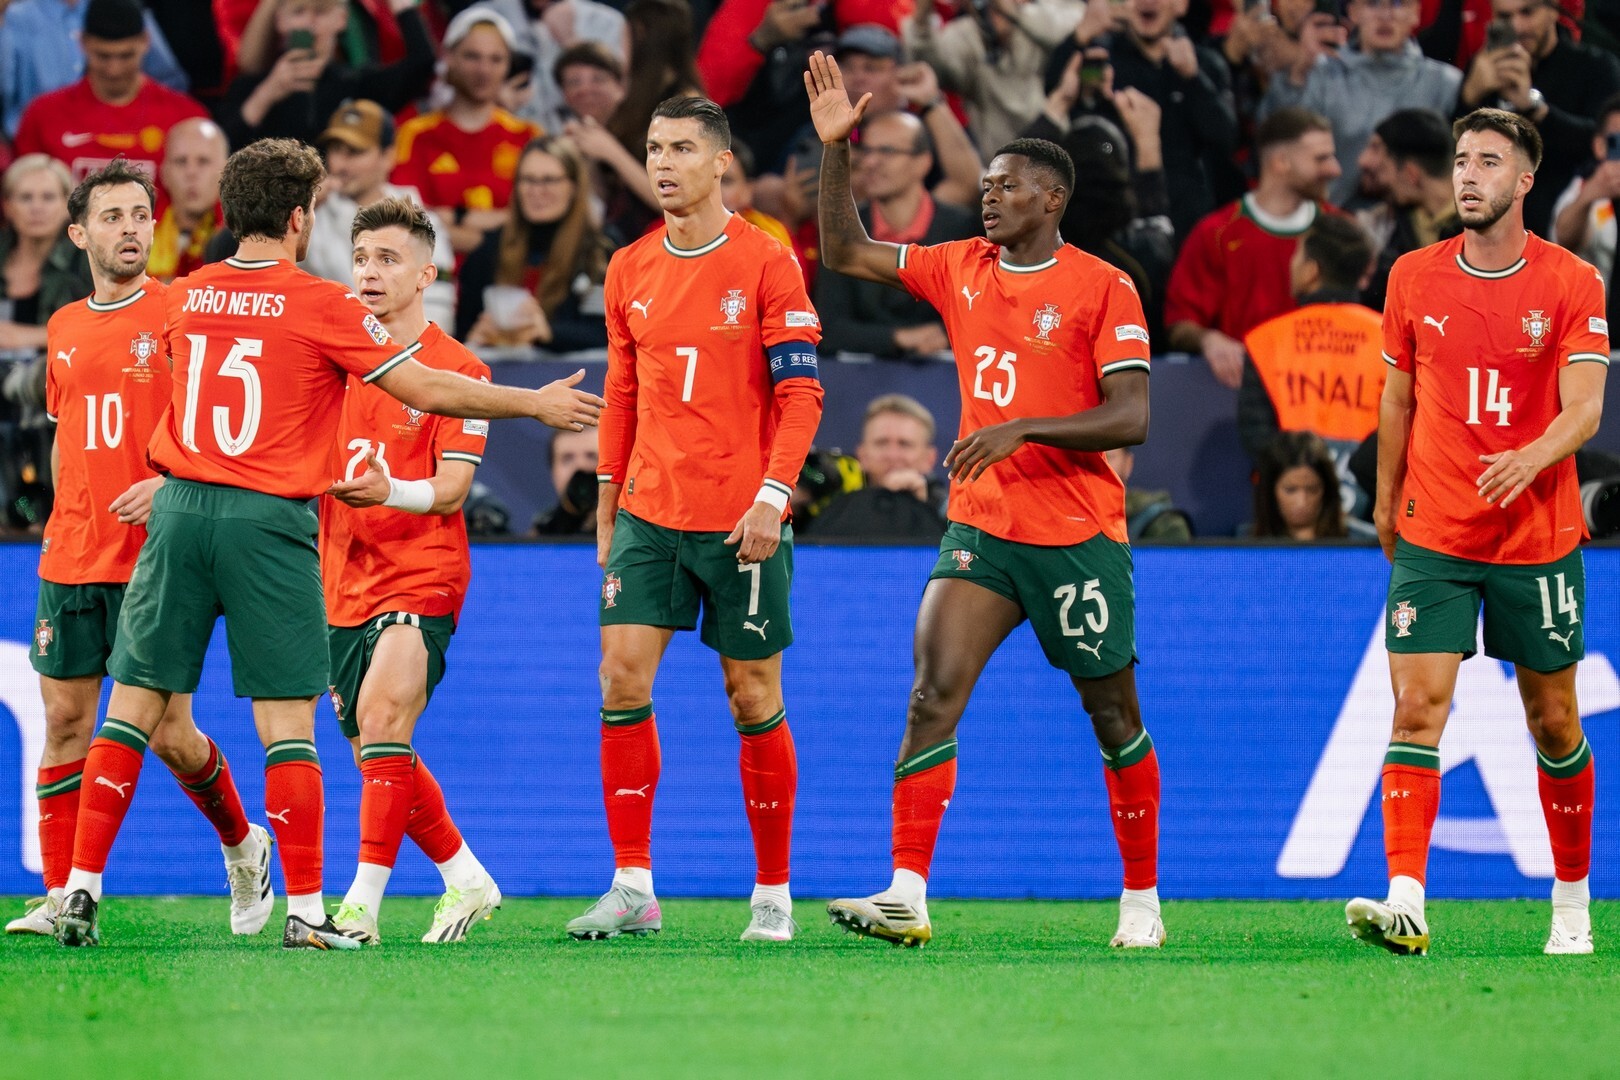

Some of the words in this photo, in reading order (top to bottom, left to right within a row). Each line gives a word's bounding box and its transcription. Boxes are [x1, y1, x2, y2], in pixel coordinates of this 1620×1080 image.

[182, 285, 227, 314] JOÃO
[227, 292, 286, 317] NEVES
[182, 333, 263, 457] 15
[675, 346, 699, 402] 7
[973, 345, 1017, 407] 25
[1278, 369, 1384, 412] INAL
[1465, 367, 1513, 427] 14
[83, 392, 123, 451] 10
[737, 562, 760, 616] 7
[1053, 578, 1109, 636] 25
[1535, 572, 1580, 629] 14
